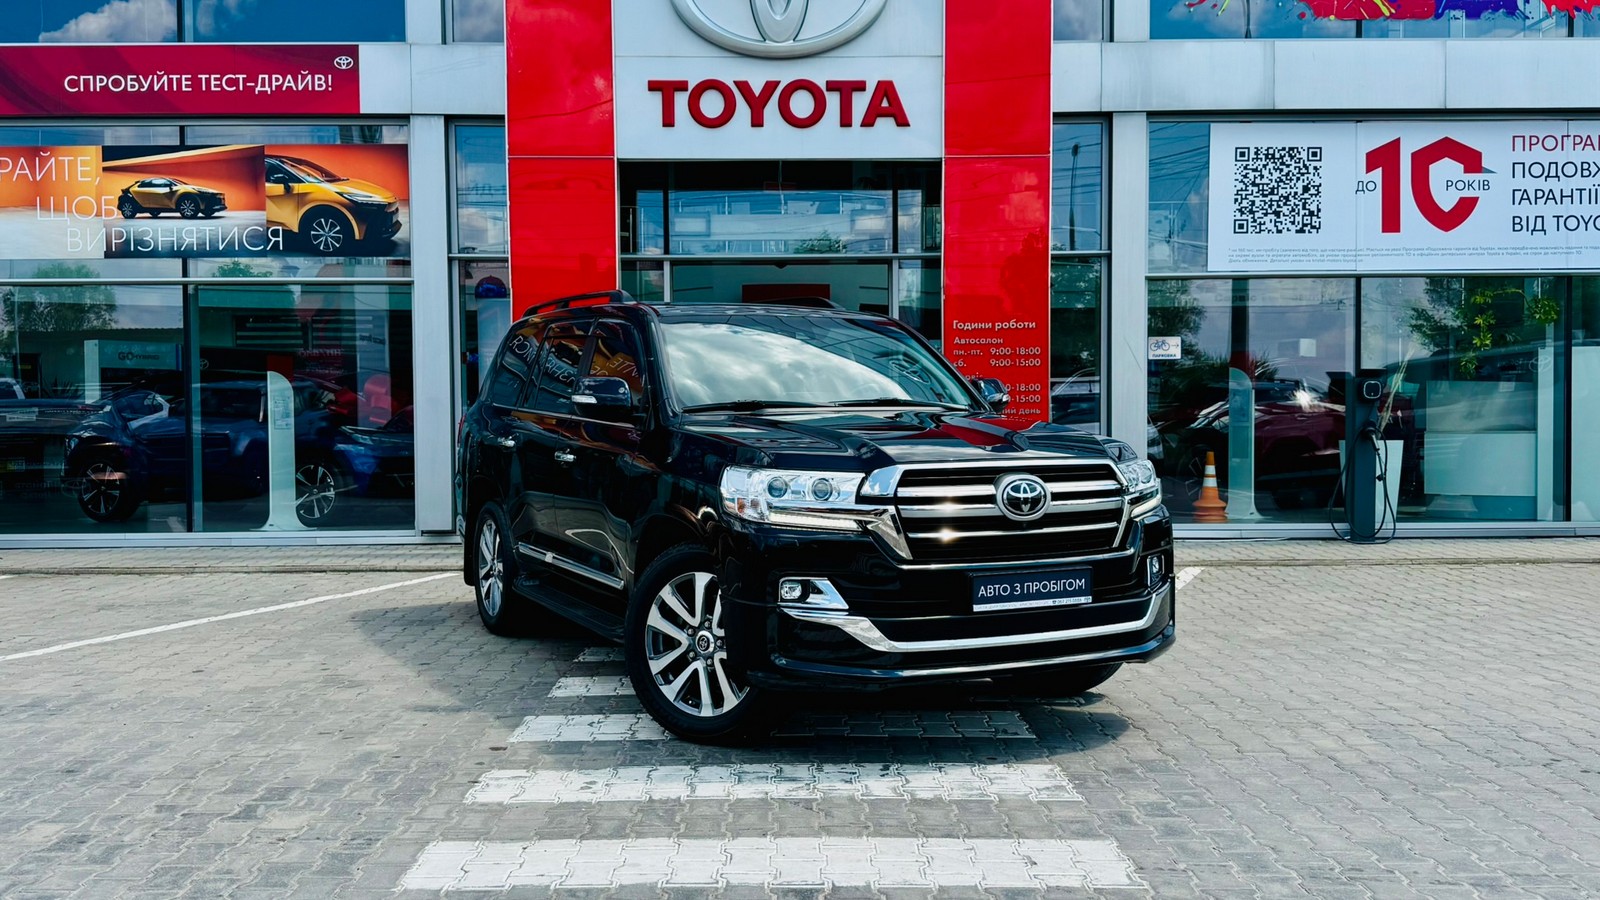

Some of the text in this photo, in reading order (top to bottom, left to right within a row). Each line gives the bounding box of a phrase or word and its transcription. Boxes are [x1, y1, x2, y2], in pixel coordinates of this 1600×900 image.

[63, 70, 333, 95] СПРОБУЙТЕ ТЕСТ-ДРАЙВ!
[647, 78, 911, 129] TOYOTA
[1511, 134, 1600, 152] ПРОГРА
[1355, 180, 1377, 195] ДО
[1445, 179, 1491, 192] РОКІВ
[36, 195, 118, 225] ЩОБ
[1511, 215, 1547, 236] ВІД
[67, 226, 284, 252] ВИРІЗНЯТИСЯ
[952, 318, 1036, 332] Години роботи
[953, 336, 1004, 345] Автосалон
[990, 346, 1041, 355] 9:00-18:00
[989, 358, 1041, 367] 9:00-15:00
[1005, 383, 1041, 391] 0-18:00
[978, 583, 1011, 598] АВТО
[1024, 578, 1086, 595] ПРОБІГОМ
